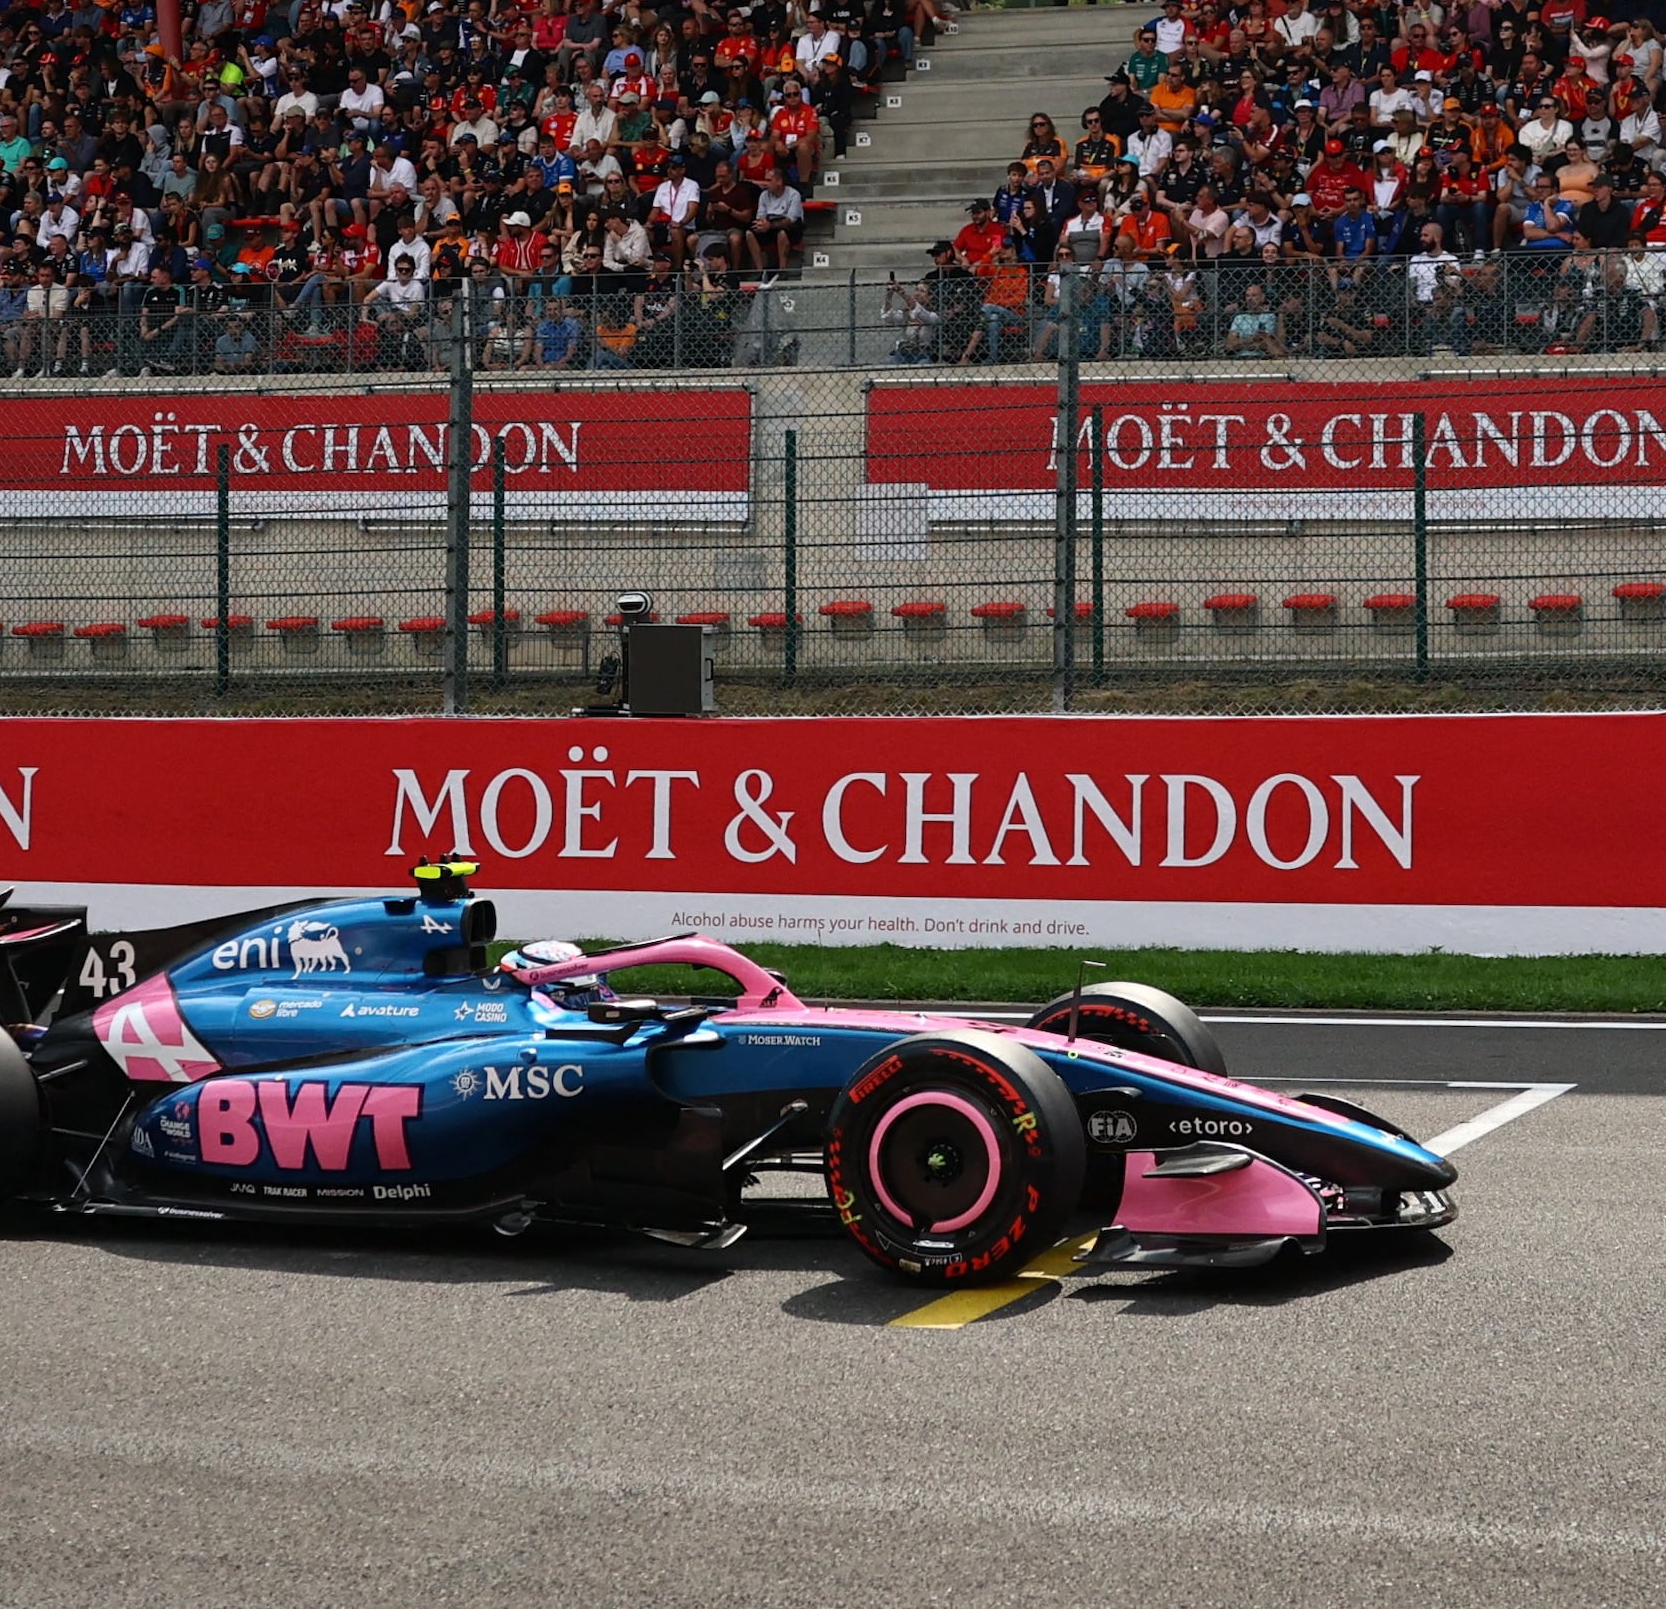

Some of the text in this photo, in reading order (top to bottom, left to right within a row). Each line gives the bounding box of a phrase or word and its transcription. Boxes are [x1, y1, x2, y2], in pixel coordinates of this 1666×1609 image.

[859, 136, 868, 144] K7
[849, 214, 859, 222] K5
[816, 256, 826, 264] K4
[60, 412, 221, 475] MOËT
[233, 422, 270, 475] &
[1260, 412, 1307, 471] &
[384, 746, 1421, 870] MOËT & CHANDON
[671, 911, 1090, 937] Alcohol abuse harms your health. Don't drink and drive.
[212, 926, 284, 969] eni
[79, 940, 136, 998] 43
[276, 1008, 299, 1018] libre
[278, 1000, 323, 1010] mercado
[357, 1003, 420, 1018] avature
[476, 1002, 504, 1013] MODO
[474, 1011, 507, 1023] CASINO
[483, 1064, 584, 1100] MSC
[197, 1078, 424, 1171] BWT
[317, 1188, 364, 1197] MISSION
[373, 1183, 432, 1200] Delphi
